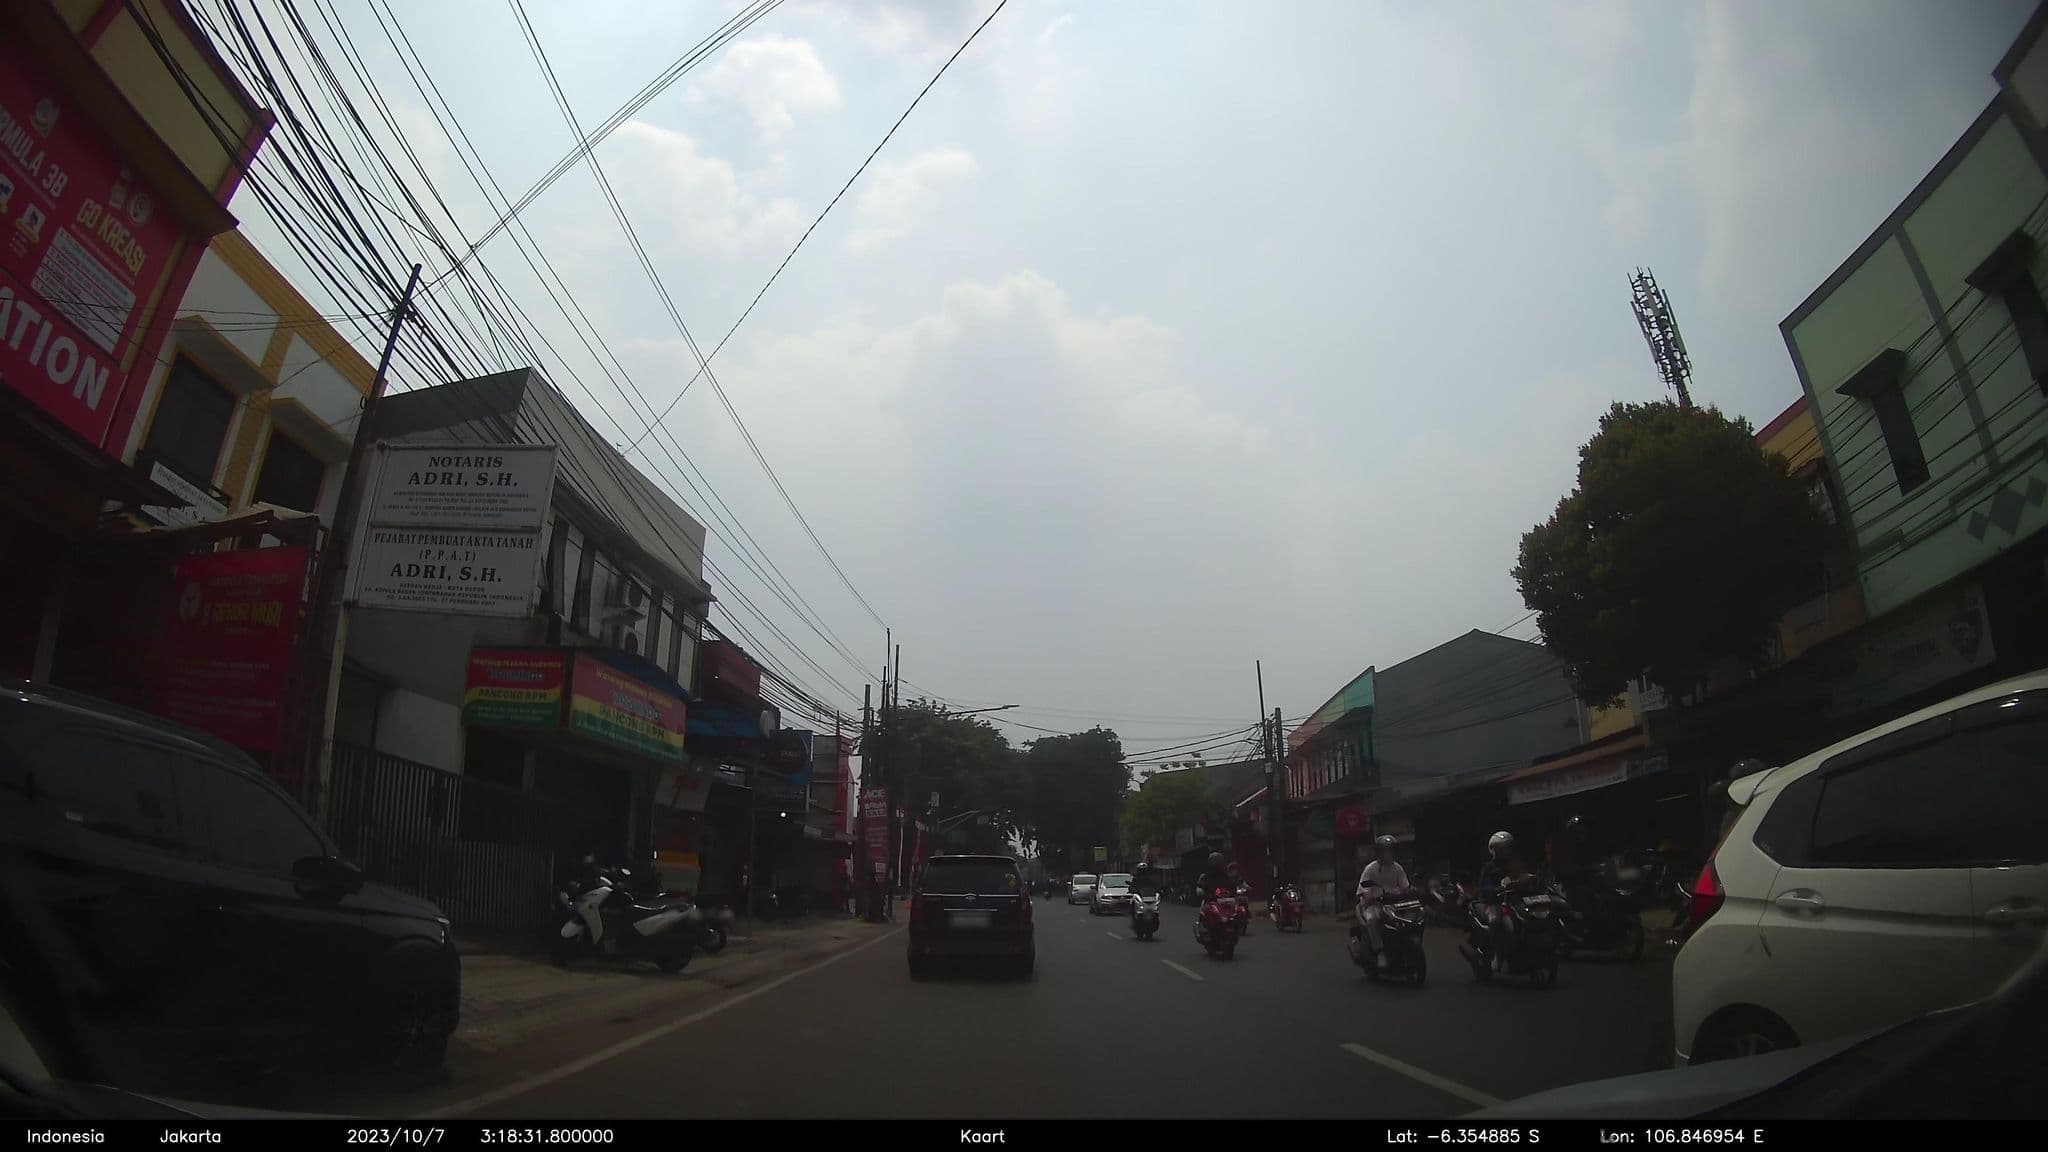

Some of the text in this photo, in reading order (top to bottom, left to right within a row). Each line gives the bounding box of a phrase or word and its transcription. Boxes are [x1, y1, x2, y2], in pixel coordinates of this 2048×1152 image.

[42, 163, 68, 198] 3B
[76, 198, 103, 229] GO
[97, 212, 147, 277] KREASI
[428, 455, 503, 469] NOTARIS
[407, 471, 519, 487] ADRI, S.H.
[373, 532, 535, 549] PEJABAT PEMBUAT AKTA TANAH
[390, 562, 503, 583] ADRI, S.H.
[478, 688, 522, 699] PANCONG
